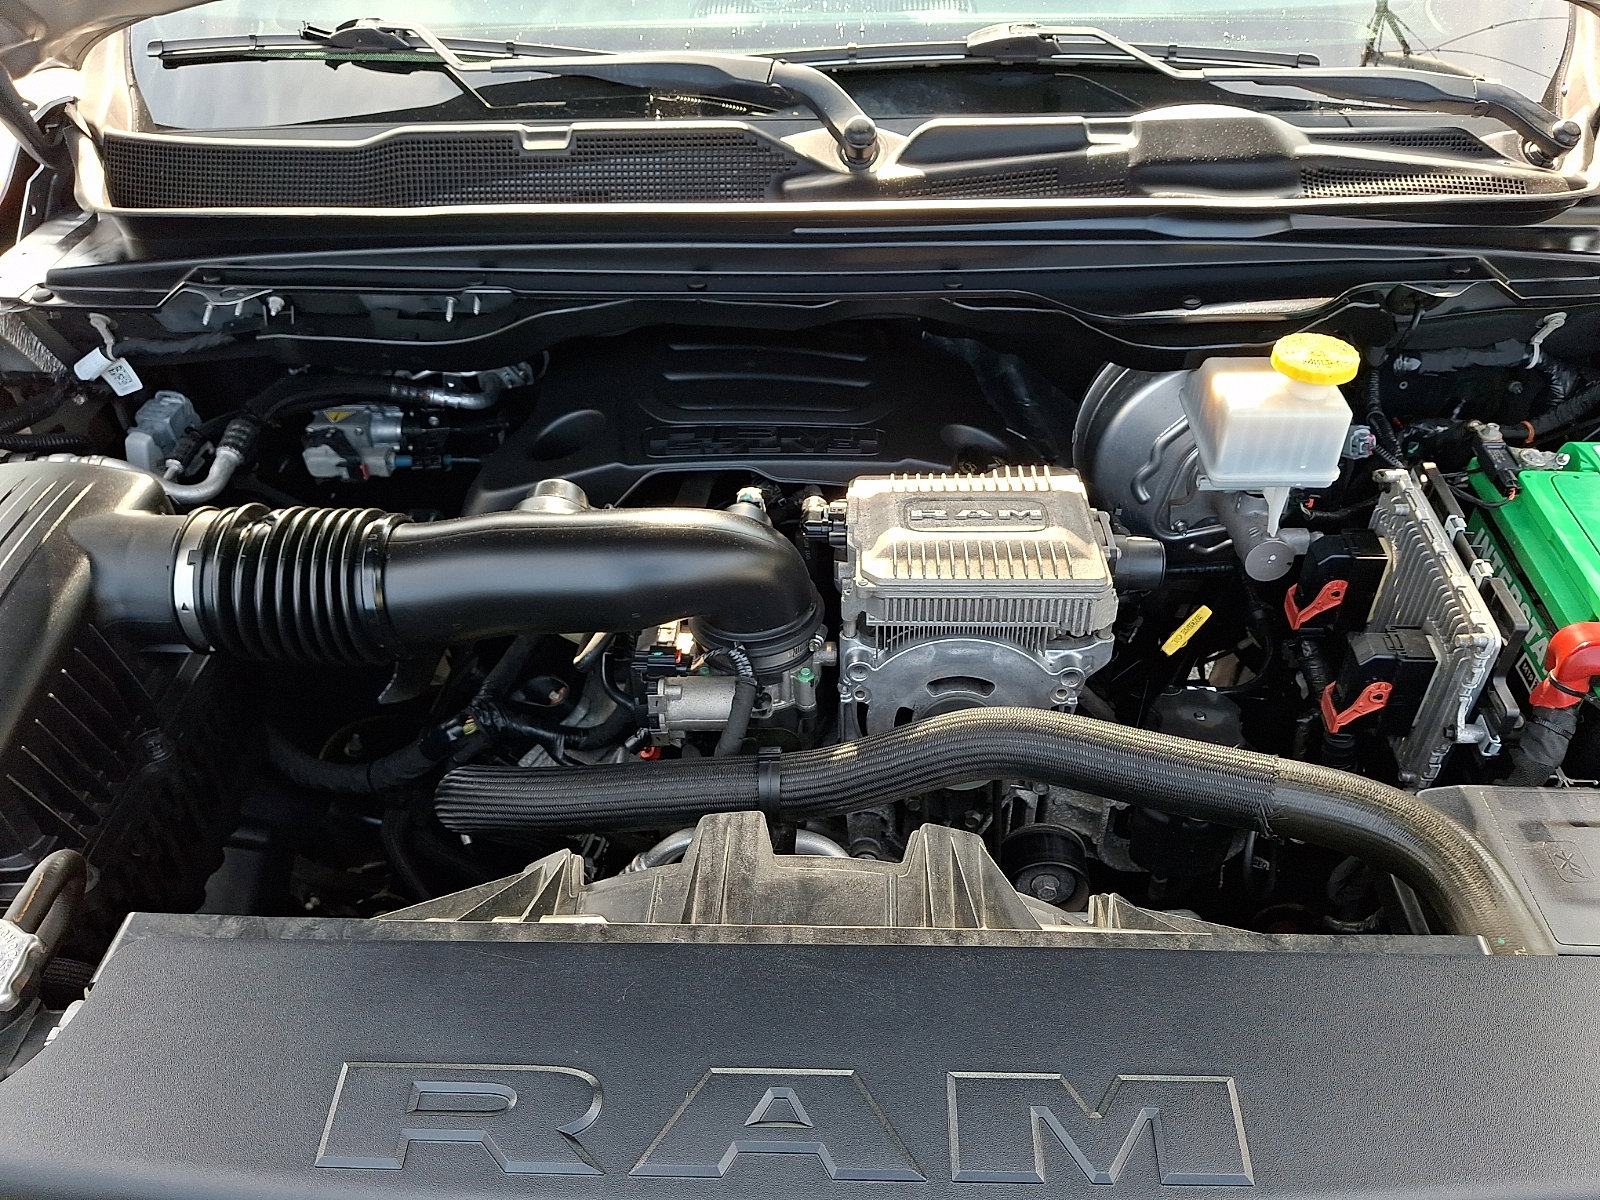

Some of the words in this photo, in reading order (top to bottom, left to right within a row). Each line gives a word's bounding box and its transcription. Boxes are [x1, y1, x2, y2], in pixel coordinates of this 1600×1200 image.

[910, 509, 1043, 520] RAM
[1473, 527, 1550, 675] INTETA
[314, 1060, 1256, 1186] RAM
